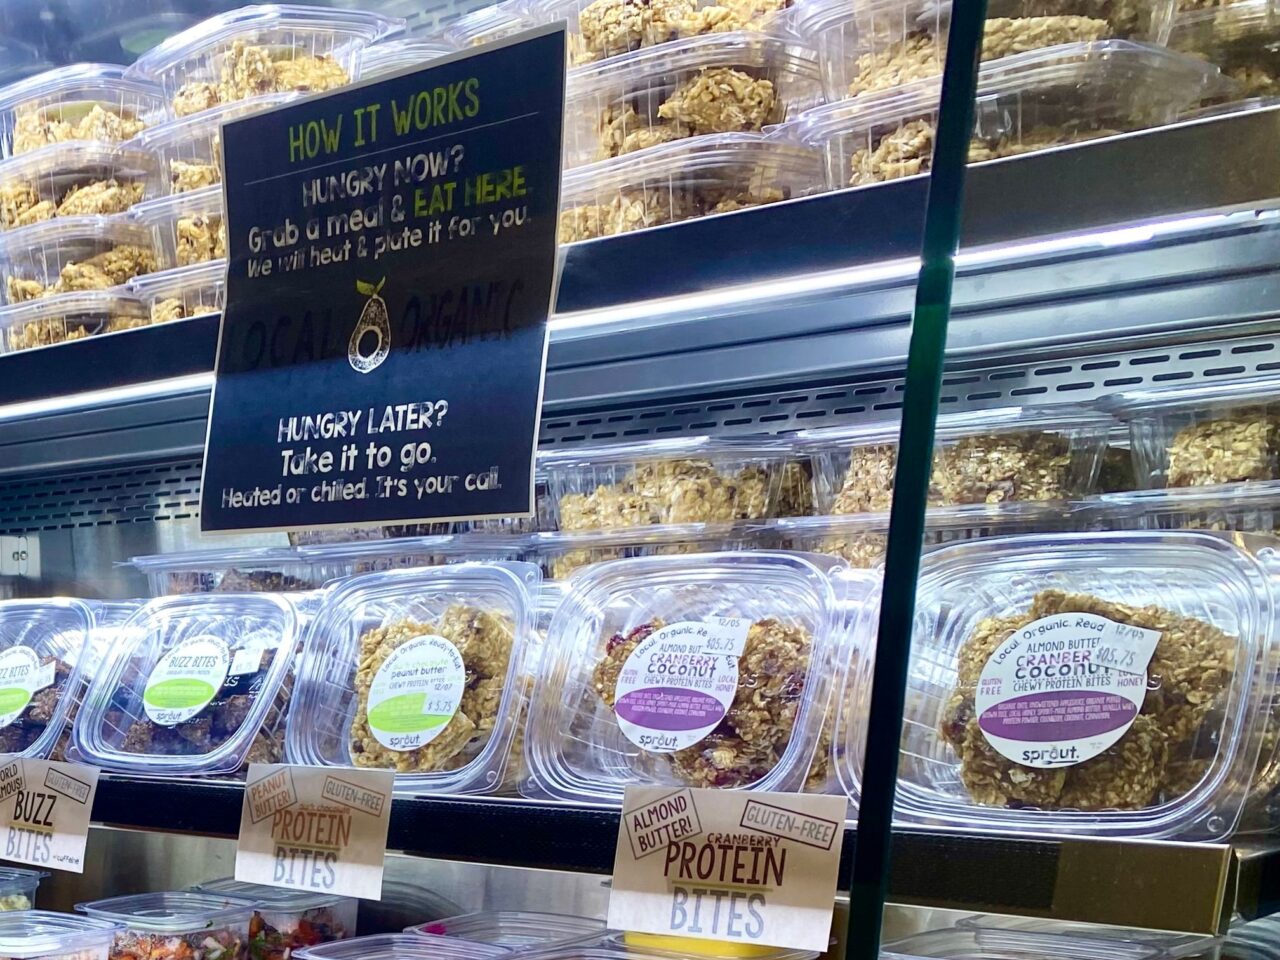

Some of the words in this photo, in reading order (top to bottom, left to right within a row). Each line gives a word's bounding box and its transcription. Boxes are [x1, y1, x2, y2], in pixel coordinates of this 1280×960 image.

[289, 115, 342, 162] HOW
[354, 104, 381, 147] IT
[391, 78, 479, 136] WORKS
[302, 163, 387, 208] HUNGRY
[395, 145, 465, 186] NOW?
[249, 219, 299, 253] Grab
[306, 221, 319, 239] a
[327, 204, 383, 237] meal
[392, 195, 405, 222] &
[414, 182, 456, 218] EAT
[248, 259, 272, 278] We
[279, 251, 304, 272] will
[310, 239, 351, 265] heat
[357, 238, 367, 257] &
[374, 226, 422, 260] plate
[428, 221, 441, 243] it
[449, 216, 481, 239] for
[278, 409, 362, 443] HUNGRY
[368, 400, 449, 434] LATER?
[282, 446, 333, 476] Take
[340, 445, 358, 471] it
[367, 443, 392, 470] to
[400, 442, 437, 472] go.
[222, 484, 281, 509] Heated
[286, 488, 306, 504] or
[311, 477, 369, 502] chilled.
[375, 476, 407, 499] It's
[414, 477, 458, 501] your
[465, 466, 502, 491] call.
[168, 656, 191, 667] BUZZ
[192, 656, 218, 667] BITES
[650, 653, 719, 666] CRANBERRY
[659, 643, 686, 654] ALMOND
[1027, 640, 1065, 653] ALMOND
[1096, 647, 1136, 666] $05.75
[9, 665, 30, 678] BITES
[389, 681, 406, 689] CHEWY
[391, 669, 418, 679] peanut
[420, 667, 447, 675] butter
[621, 676, 636, 685] FREE
[643, 677, 665, 685] CHEWY
[667, 677, 694, 687] PROTEIN
[695, 679, 714, 689] BITES
[718, 675, 736, 683] LOCAL
[1013, 682, 1042, 692] CHEWY
[1046, 679, 1082, 690] PROTEIN
[1086, 677, 1111, 687] BITES
[1117, 677, 1144, 688] HONEY
[715, 684, 734, 693] HONEY
[980, 686, 1002, 695] FREE
[251, 771, 287, 801] PEANUT
[326, 781, 381, 811] GLUTEN-FREE
[14, 790, 57, 827] BUZZ
[255, 790, 291, 818] BUTTER!
[633, 795, 688, 832] ALMOND
[271, 809, 352, 847] PROTEIN
[638, 815, 693, 852] BUTTER!
[746, 805, 832, 843] GLUTEN-FREE
[6, 826, 52, 863] BITES
[707, 832, 781, 848] CRANBERRY
[273, 846, 337, 889] BITES
[664, 841, 787, 887] PROTEIN
[670, 886, 766, 939] BITES
